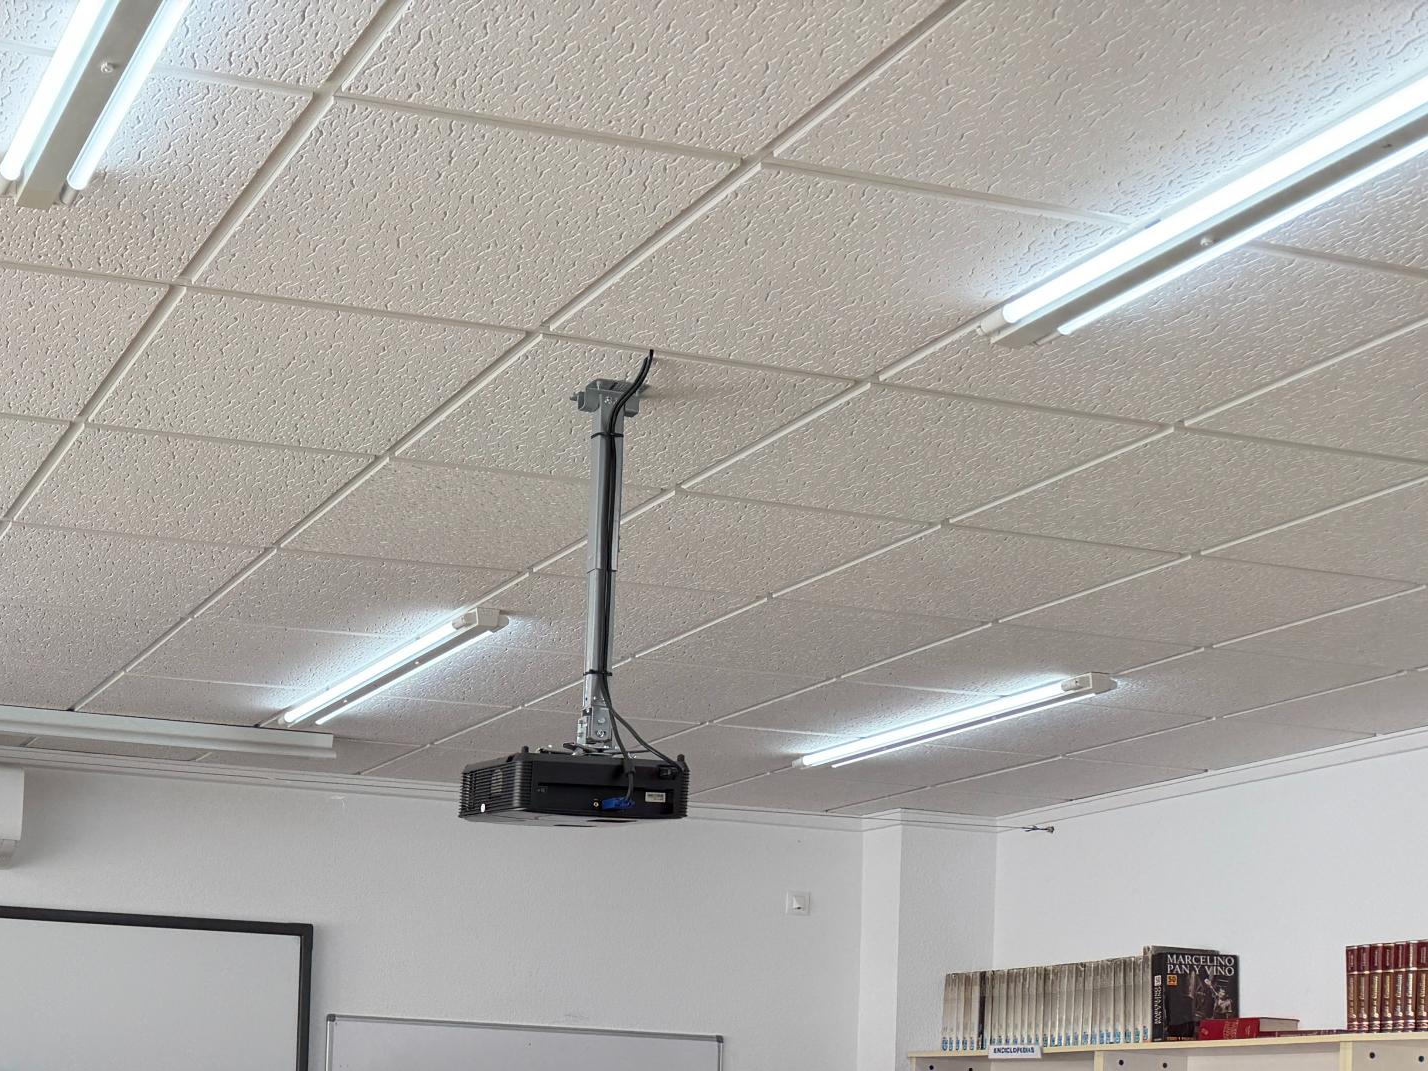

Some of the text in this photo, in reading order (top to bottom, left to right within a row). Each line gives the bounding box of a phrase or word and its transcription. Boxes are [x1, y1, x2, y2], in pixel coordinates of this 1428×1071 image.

[1167, 955, 1234, 967] MARCELINO
[1167, 965, 1234, 976] PAN Y VINO
